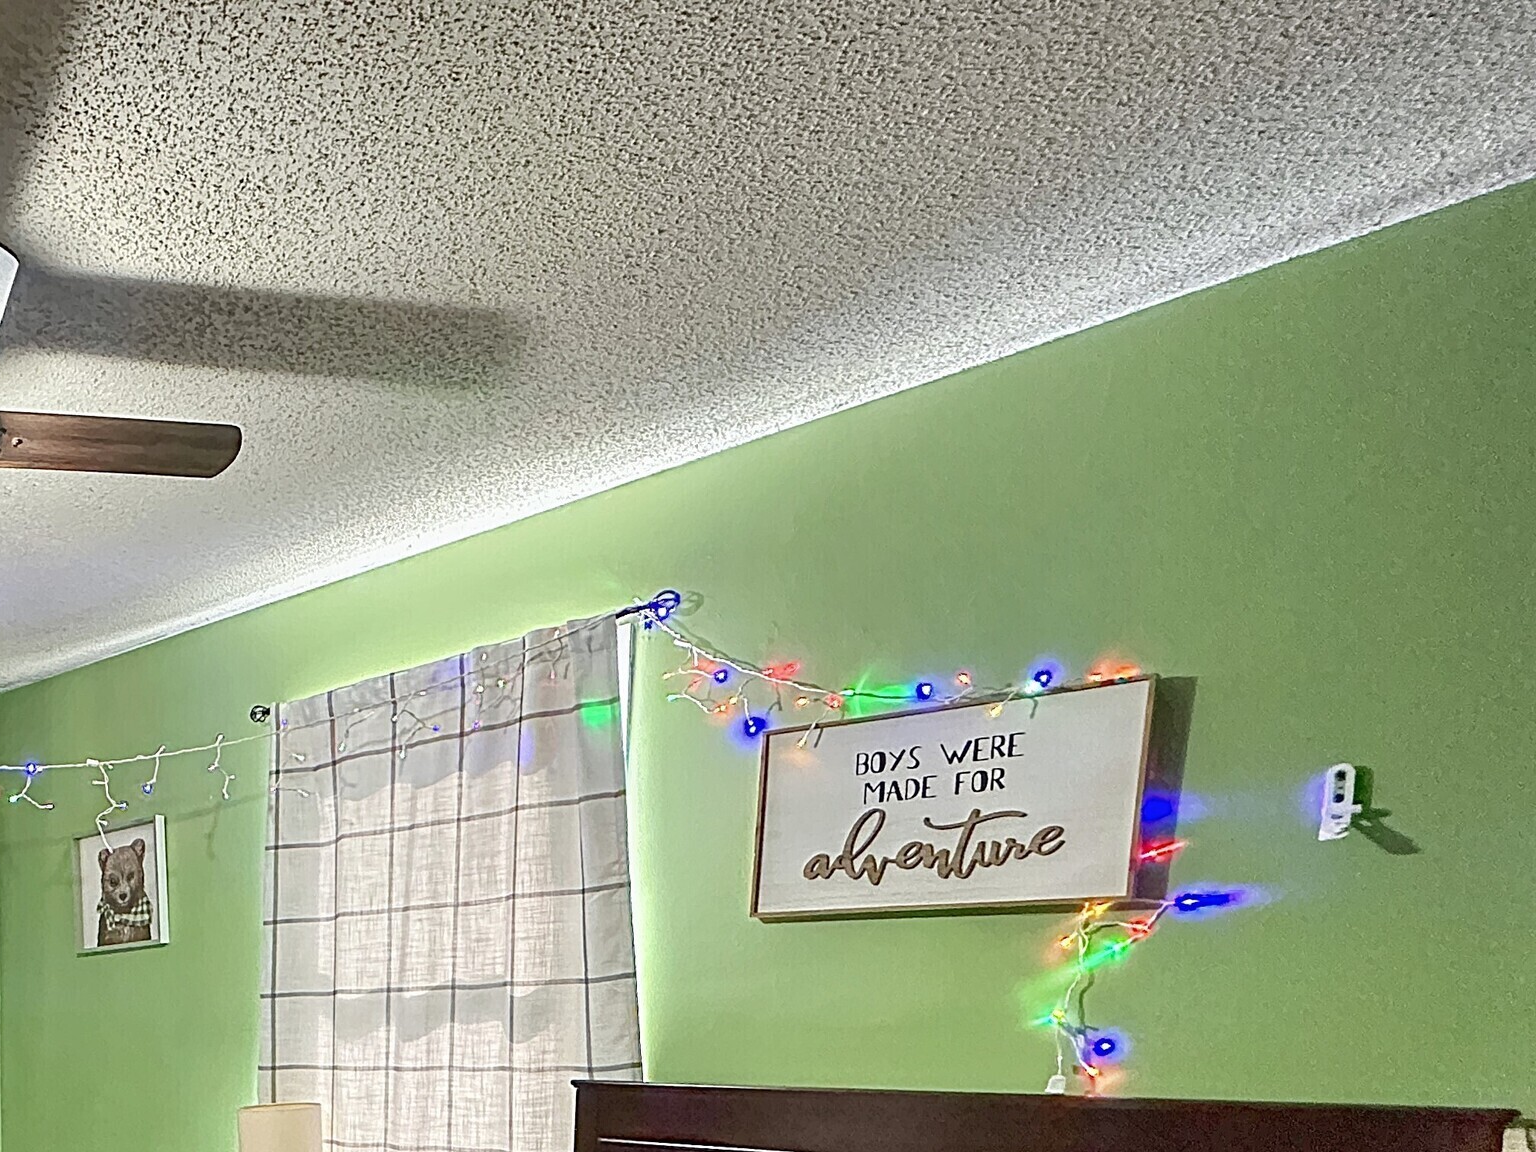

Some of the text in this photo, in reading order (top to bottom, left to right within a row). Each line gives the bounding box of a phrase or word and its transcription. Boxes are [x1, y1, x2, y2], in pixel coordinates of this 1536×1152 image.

[855, 731, 1026, 777] BOYS WERE
[863, 767, 1006, 805] MADE FOR
[802, 807, 1066, 886] adventure
